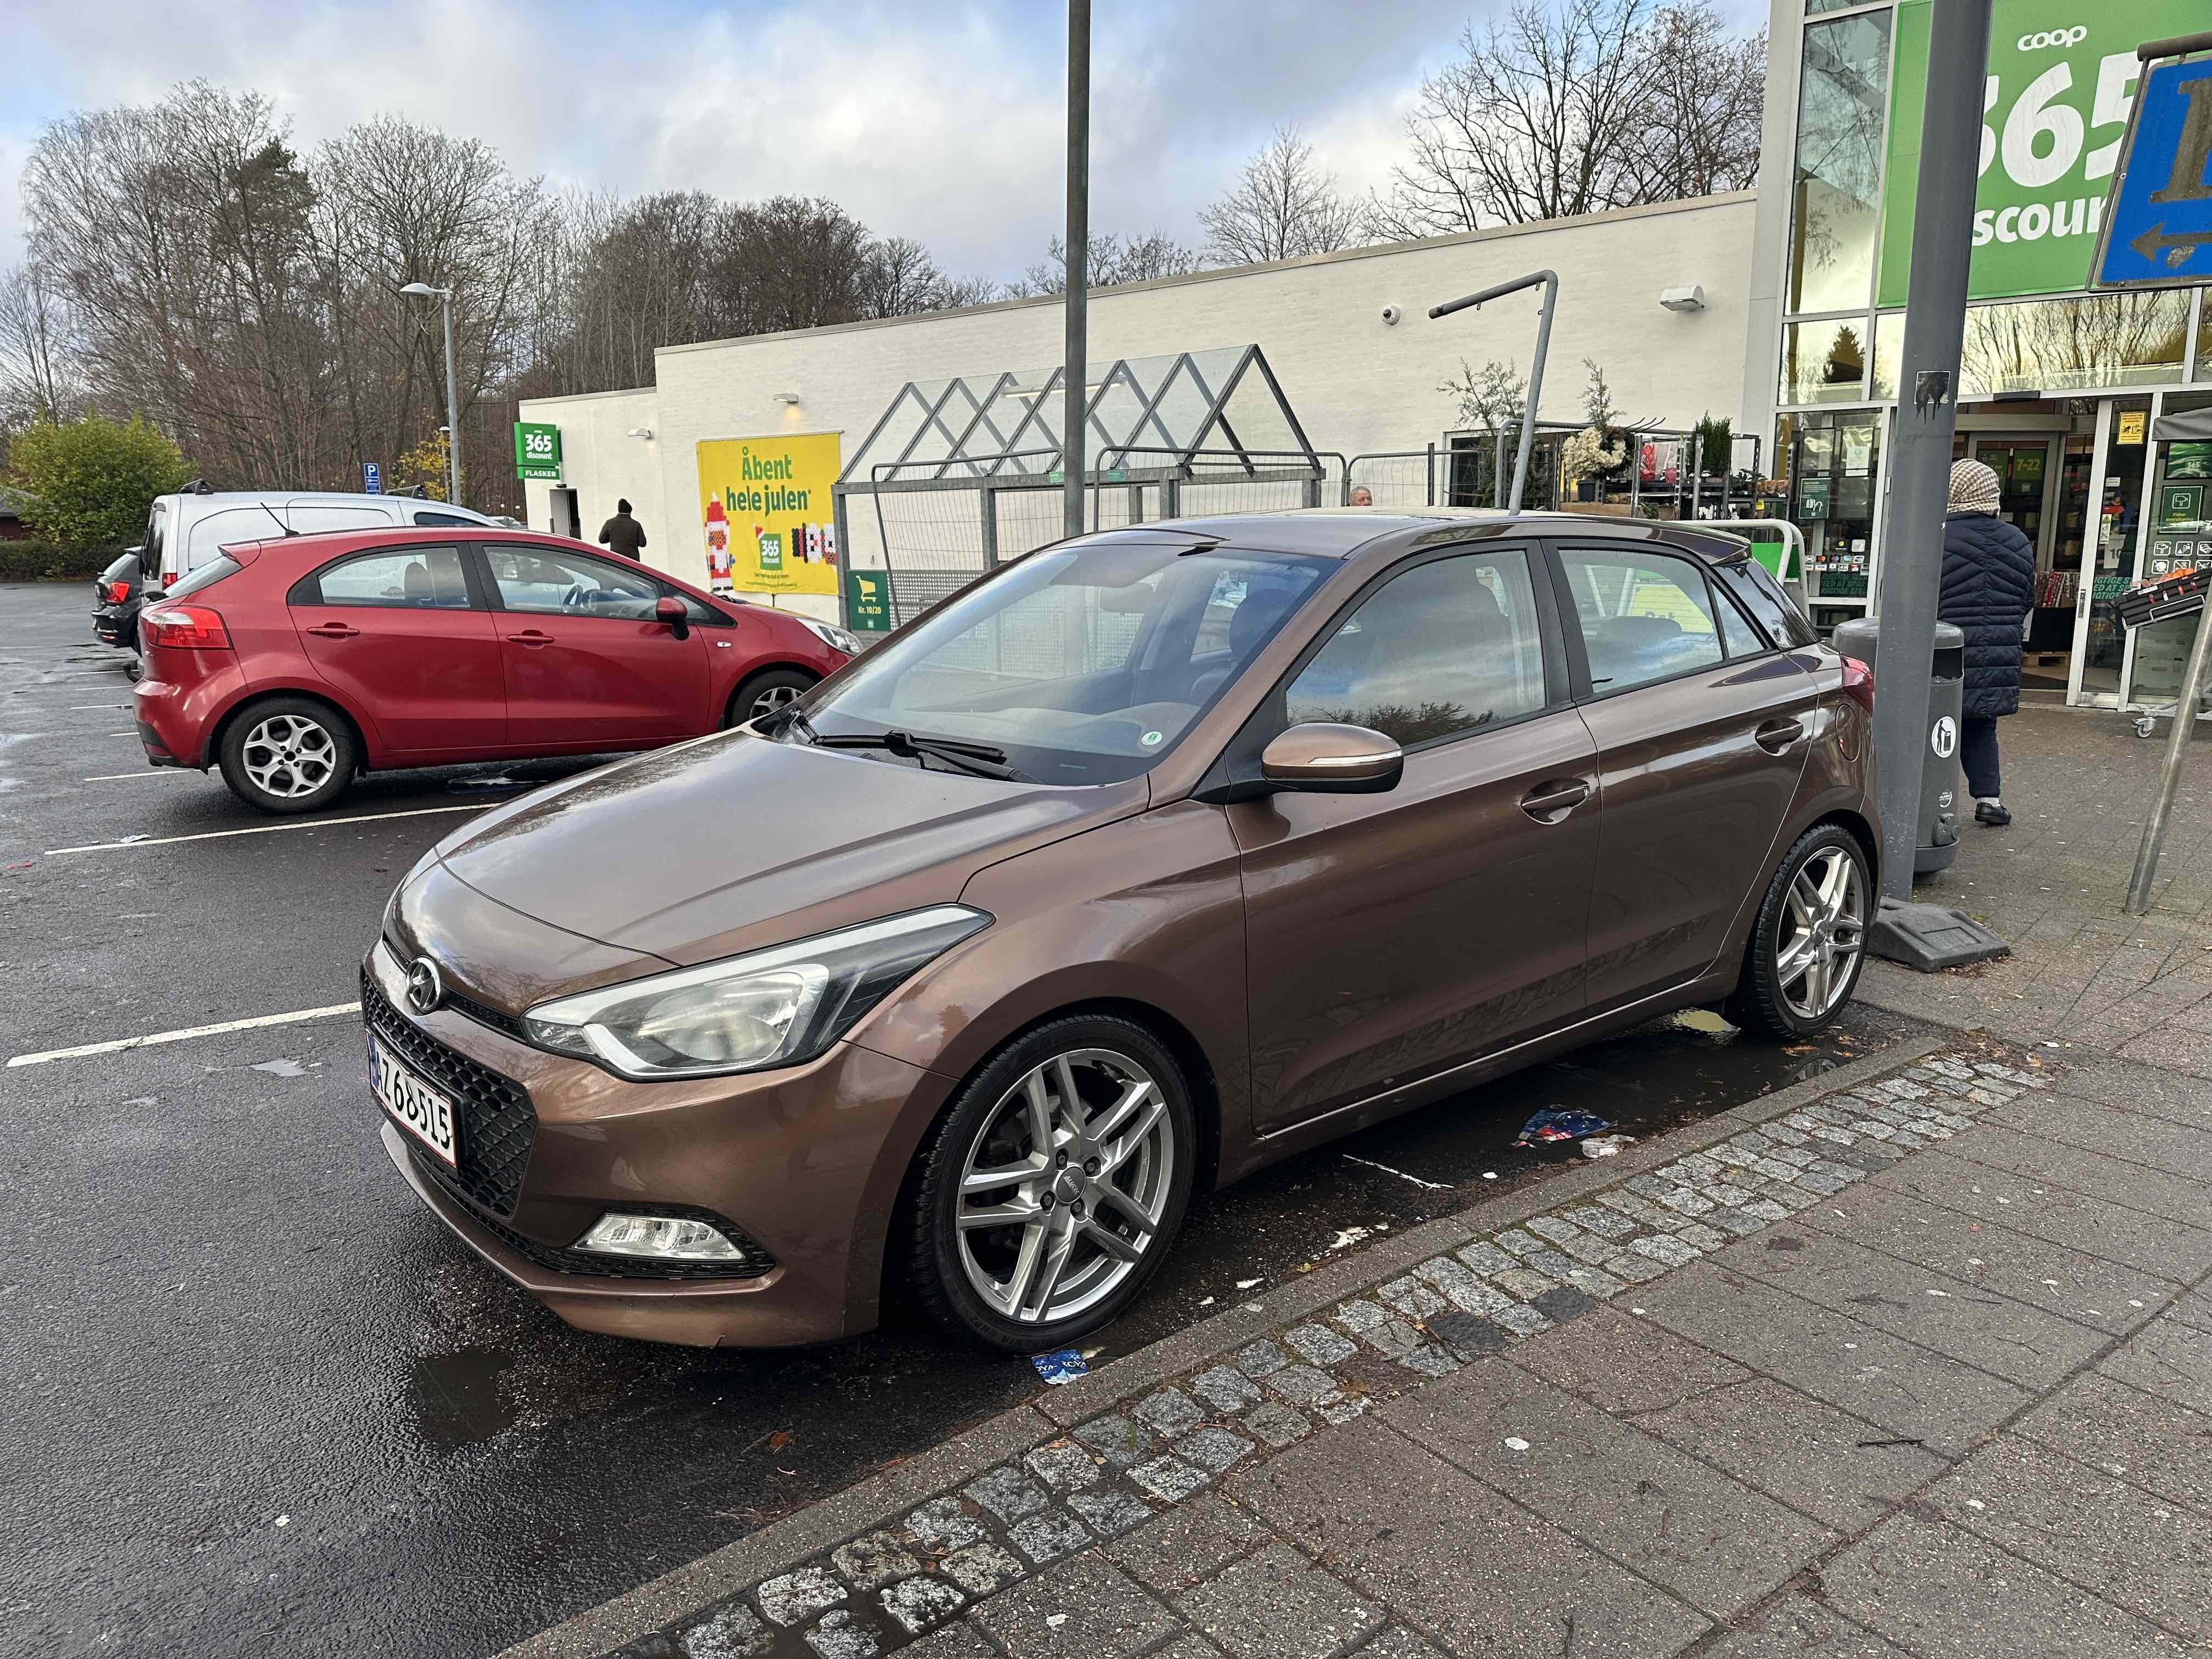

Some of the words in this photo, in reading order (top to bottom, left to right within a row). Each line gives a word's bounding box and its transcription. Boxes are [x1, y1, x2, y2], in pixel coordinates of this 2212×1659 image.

[2017, 25, 2087, 51] coop
[525, 434, 552, 452] 365
[527, 452, 552, 460] discount
[742, 446, 793, 481] Åbent
[367, 465, 376, 476] P
[2017, 459, 2040, 471] 7-22
[726, 486, 761, 511] hele
[761, 540, 779, 557] 365
[866, 606, 882, 614] 10/20
